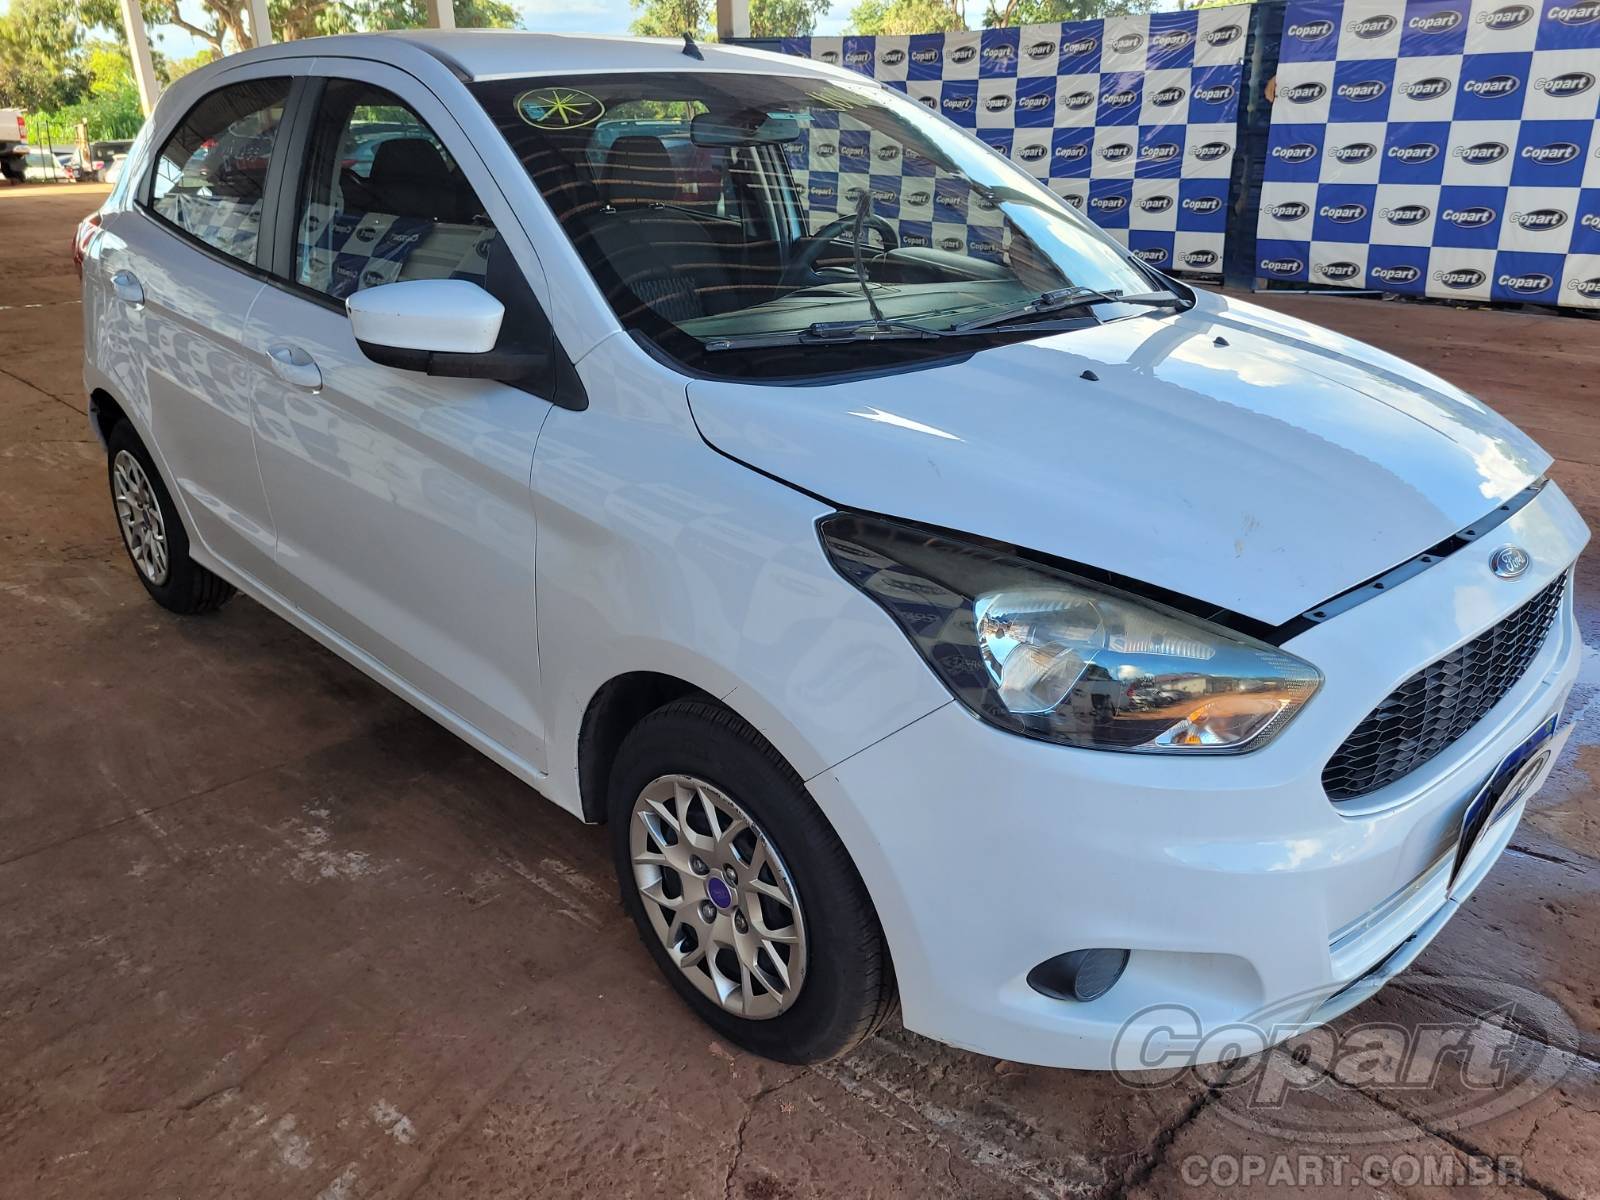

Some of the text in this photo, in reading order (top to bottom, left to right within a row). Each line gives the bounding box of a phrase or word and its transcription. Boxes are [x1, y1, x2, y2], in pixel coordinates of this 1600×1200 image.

[1408, 14, 1456, 31] Copart
[1476, 9, 1528, 25] Copart
[1287, 22, 1330, 37] Copart
[1346, 19, 1391, 35] Copart
[1152, 33, 1188, 46] Copart
[984, 45, 1011, 58] Copart
[1063, 40, 1094, 54] Copart
[911, 51, 936, 62] Copart
[1280, 85, 1320, 98] Copart
[1337, 84, 1381, 97] Copart
[1399, 80, 1443, 95] Copart
[1464, 79, 1513, 93] Copart
[1534, 78, 1587, 93] Copart
[1102, 92, 1133, 104] Copart
[1194, 87, 1230, 99] Copart
[943, 98, 970, 108] Copart
[1019, 97, 1048, 107] Copart
[1056, 147, 1084, 158] Copart
[1141, 145, 1175, 157] Copart
[1272, 145, 1312, 158] Copart
[1328, 146, 1371, 159] Copart
[1388, 146, 1433, 159] Copart
[1453, 146, 1500, 160] Copart
[1521, 146, 1573, 160] Copart
[1091, 199, 1123, 210] Copart
[1182, 199, 1217, 210] Copart
[1263, 204, 1303, 216] Copart
[1320, 206, 1361, 219] Copart
[1379, 207, 1424, 221] Copart
[1442, 209, 1490, 223] Copart
[1510, 211, 1559, 226] Copart
[1261, 259, 1298, 271] Copart
[1314, 263, 1354, 276] Copart
[1371, 266, 1414, 280] Copart
[1433, 271, 1479, 285] Copart
[1498, 275, 1547, 289] Copart
[1568, 280, 1600, 295] Copa
[1501, 550, 1525, 571] Ford
